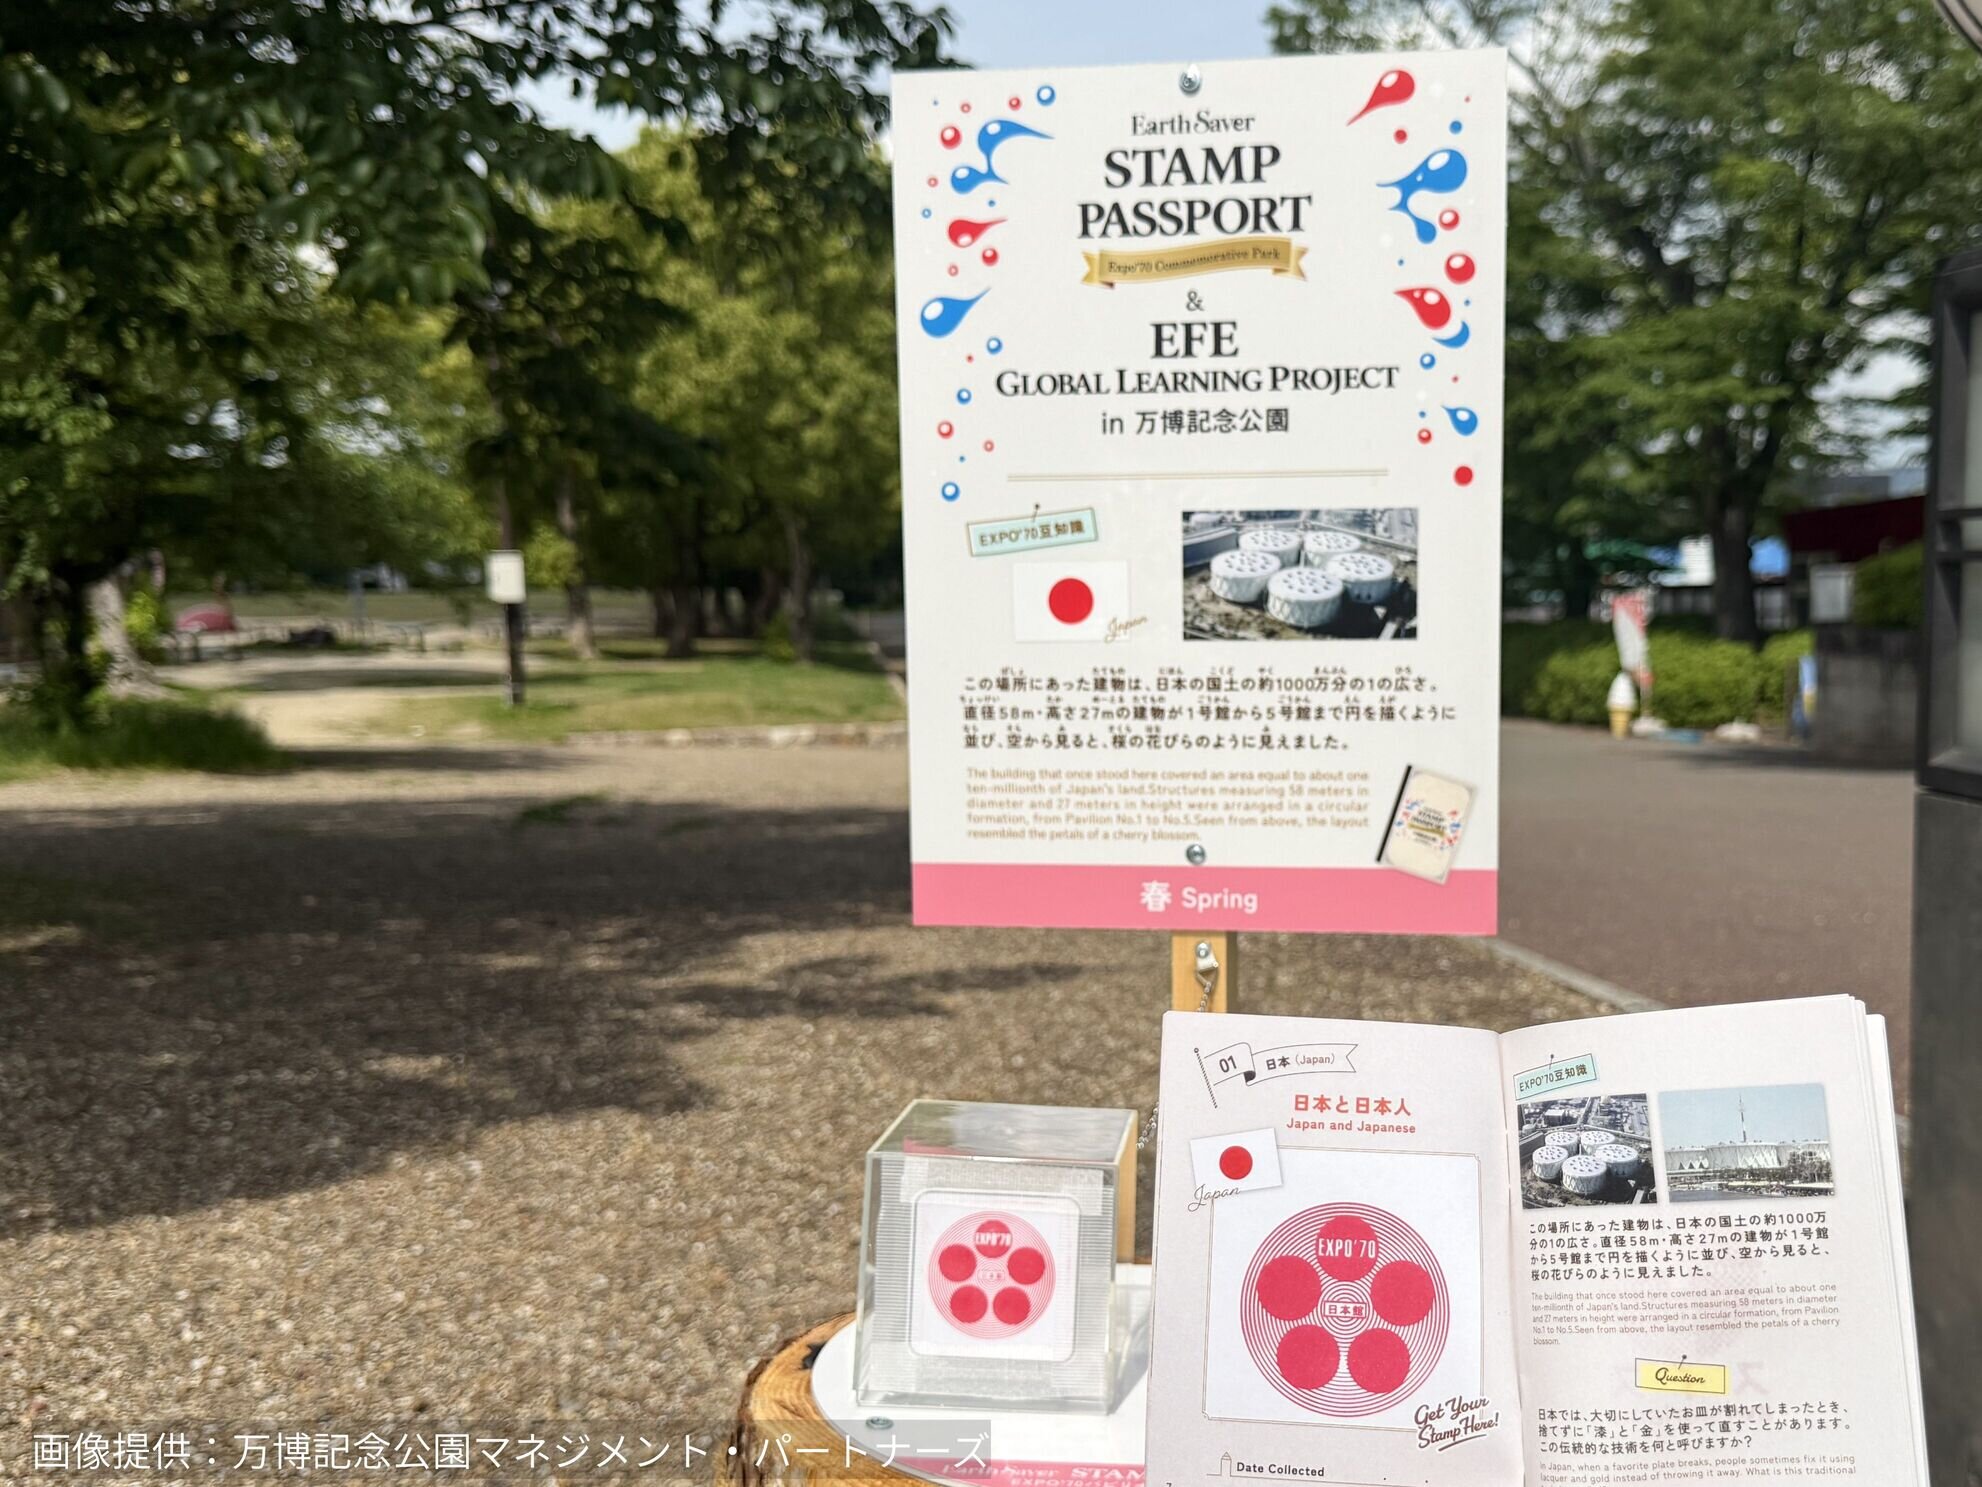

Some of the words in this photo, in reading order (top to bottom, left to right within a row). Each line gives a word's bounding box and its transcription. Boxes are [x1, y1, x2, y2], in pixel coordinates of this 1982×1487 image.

[1104, 144, 1281, 188] STAMP
[1077, 195, 1313, 239] PASSPORT
[1155, 250, 1249, 272] Commemorative
[1252, 247, 1281, 260] Park
[1185, 290, 1204, 311] &
[1150, 321, 1239, 359] EFE
[996, 370, 1110, 397] GLOBAL
[1116, 369, 1263, 395] LEARNING
[1269, 366, 1400, 395] PROJECT
[1102, 412, 1124, 435] in
[1135, 408, 1289, 435] 万博記念公園
[1104, 613, 1148, 643] Japan
[1140, 880, 1172, 912] 春
[1182, 886, 1258, 914] Spring
[1219, 1055, 1237, 1073] 01
[1266, 1056, 1290, 1070] 日本
[1294, 1053, 1335, 1067] (Japan)
[1520, 1064, 1587, 1092] EXPO'70豆知識
[1294, 1094, 1411, 1116] 日本と日本人
[1286, 1118, 1325, 1132] Japan
[1330, 1120, 1352, 1131] and
[1357, 1120, 1416, 1134] Japanese
[1187, 1183, 1242, 1212] Japan
[1530, 1211, 1826, 1234] この場所にあった建物は、日本の国土の約1000万
[1318, 1238, 1376, 1259] EXPO'70
[1531, 1243, 1830, 1265] から5号館まで円を描くように並び、空から見ると、
[1531, 1265, 1711, 1281] 桜の花びらのように見えました。
[1532, 1292, 1542, 1301] The
[1544, 1291, 1573, 1302] building
[1576, 1291, 1592, 1300] that
[1596, 1292, 1616, 1300] once
[1618, 1289, 1644, 1299] stood
[1647, 1289, 1668, 1298] here
[1670, 1287, 1707, 1298] covered
[1724, 1288, 1745, 1296] area
[1748, 1284, 1773, 1297] equal
[1776, 1285, 1786, 1293] to
[1789, 1282, 1816, 1293] about
[1328, 1304, 1365, 1317] 日本館
[1532, 1302, 1573, 1311] ten-millionth
[1576, 1302, 1583, 1311] of
[1586, 1301, 1618, 1313] Japan's
[1690, 1298, 1736, 1311] measuring
[1738, 1296, 1749, 1306] 58
[1752, 1296, 1783, 1306] meters
[1786, 1295, 1794, 1304] in
[1796, 1293, 1836, 1304] diameter
[1532, 1313, 1543, 1322] and
[1544, 1313, 1551, 1322] 27
[1552, 1314, 1578, 1322] meters
[1580, 1314, 1587, 1322] in
[1589, 1312, 1615, 1324] height
[1640, 1311, 1679, 1323] arranged
[1681, 1311, 1689, 1320] in
[1699, 1308, 1731, 1319] circular
[1734, 1306, 1778, 1319] formation,
[1781, 1305, 1802, 1316] from
[1804, 1304, 1839, 1315] Pavilion
[1547, 1325, 1554, 1333] to
[1596, 1323, 1616, 1333] from
[1619, 1323, 1647, 1334] above,
[1650, 1323, 1664, 1332] the
[1666, 1322, 1693, 1334] layout
[1696, 1320, 1741, 1331] resembled
[1744, 1319, 1758, 1329] the
[1761, 1317, 1788, 1330] petals
[1791, 1317, 1800, 1327] of
[1811, 1315, 1840, 1328] cherry
[1655, 1367, 1705, 1385] Question
[1414, 1403, 1445, 1427] Get
[1445, 1395, 1489, 1420] Your
[1538, 1401, 1848, 1421] 日本では、大切にしていたお皿が割れてしまったとき、
[1418, 1424, 1461, 1448] Stamp
[1459, 1412, 1499, 1435] Here!
[1236, 1462, 1264, 1473] Date
[1268, 1464, 1325, 1477] Collected
[1540, 1461, 1546, 1470] In
[1548, 1461, 1574, 1473] Japan,
[1577, 1461, 1600, 1471] when
[1612, 1459, 1649, 1470] favorite
[1652, 1458, 1675, 1470] plate
[1677, 1457, 1712, 1468] breaks,
[1715, 1456, 1746, 1468] people
[1750, 1455, 1800, 1465] sometimes
[1804, 1454, 1815, 1464] fix
[1819, 1455, 1826, 1463] it
[1829, 1454, 1855, 1465] using
[1540, 1472, 1567, 1483] lacquer
[1570, 1472, 1587, 1482] and
[1590, 1472, 1610, 1484] gold
[1613, 1471, 1647, 1481] instead
[1650, 1470, 1660, 1480] of
[1663, 1468, 1703, 1481] throwing
[1706, 1469, 1713, 1477] it
[1716, 1470, 1742, 1478] away.
[1745, 1466, 1770, 1476] What
[1773, 1467, 1781, 1475] is
[1784, 1465, 1802, 1475] this
[1806, 1464, 1856, 1475] traditional
